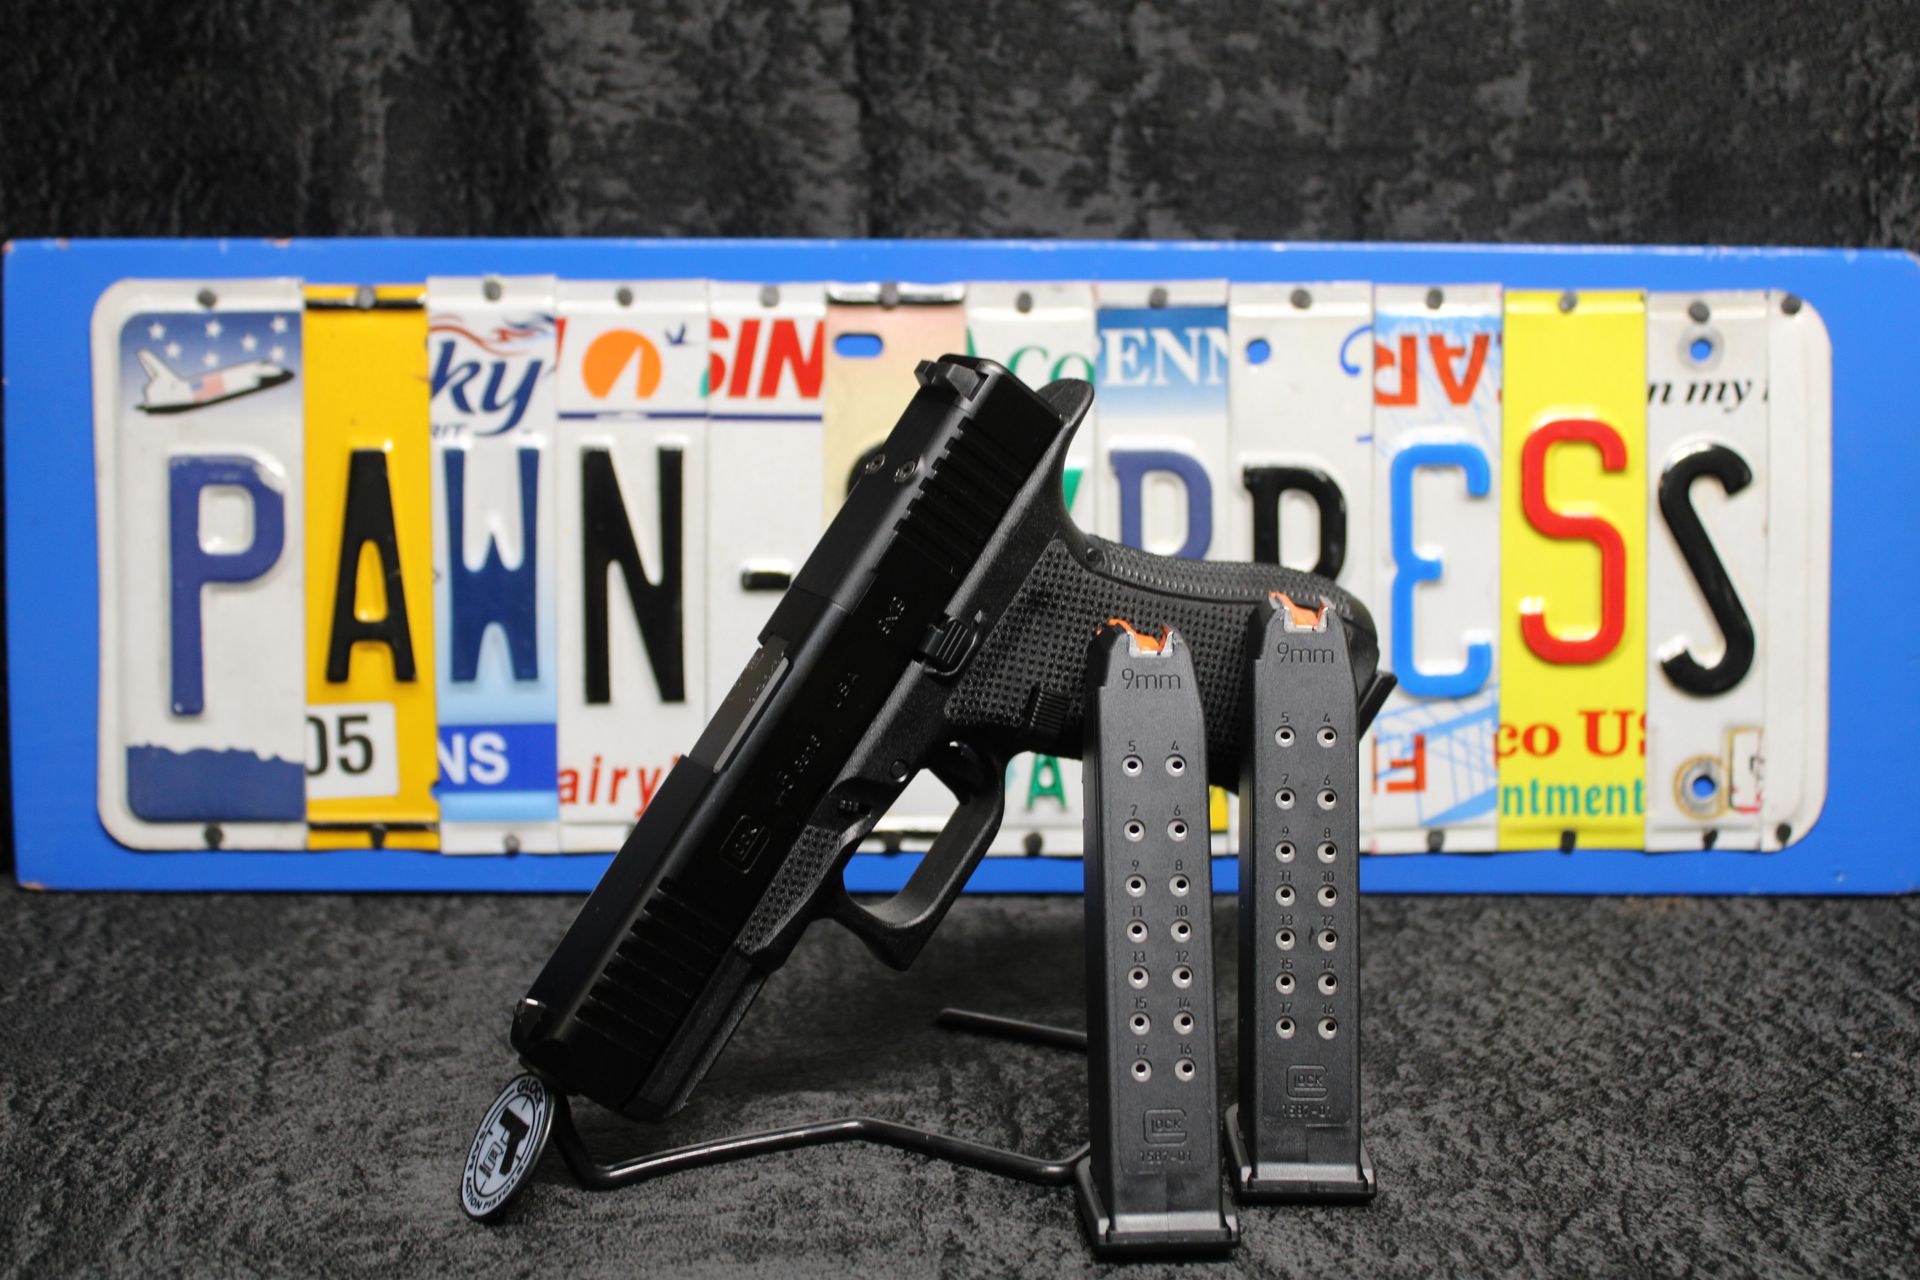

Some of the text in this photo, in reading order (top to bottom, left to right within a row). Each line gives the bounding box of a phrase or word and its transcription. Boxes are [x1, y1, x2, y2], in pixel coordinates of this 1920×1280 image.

[1685, 380, 1752, 413] my
[1277, 642, 1335, 664] 9mm
[1121, 667, 1181, 690] 9mm
[1281, 712, 1331, 723] 5 4
[1128, 741, 1179, 752] 5 4
[559, 754, 681, 816] airy
[1281, 774, 1331, 786] 7 6
[1130, 805, 1181, 816] 7 6
[1281, 827, 1331, 838] 9 8
[1131, 860, 1183, 872] 9 8
[1322, 872, 1335, 883] 10
[1175, 906, 1188, 916] 10
[1280, 915, 1334, 926] 13 12
[1132, 952, 1189, 963] 13 12
[1280, 959, 1335, 970] 15 14
[1134, 998, 1190, 1009] 15 14
[1280, 1003, 1335, 1014] 17 16
[1135, 1044, 1192, 1055] 17 16
